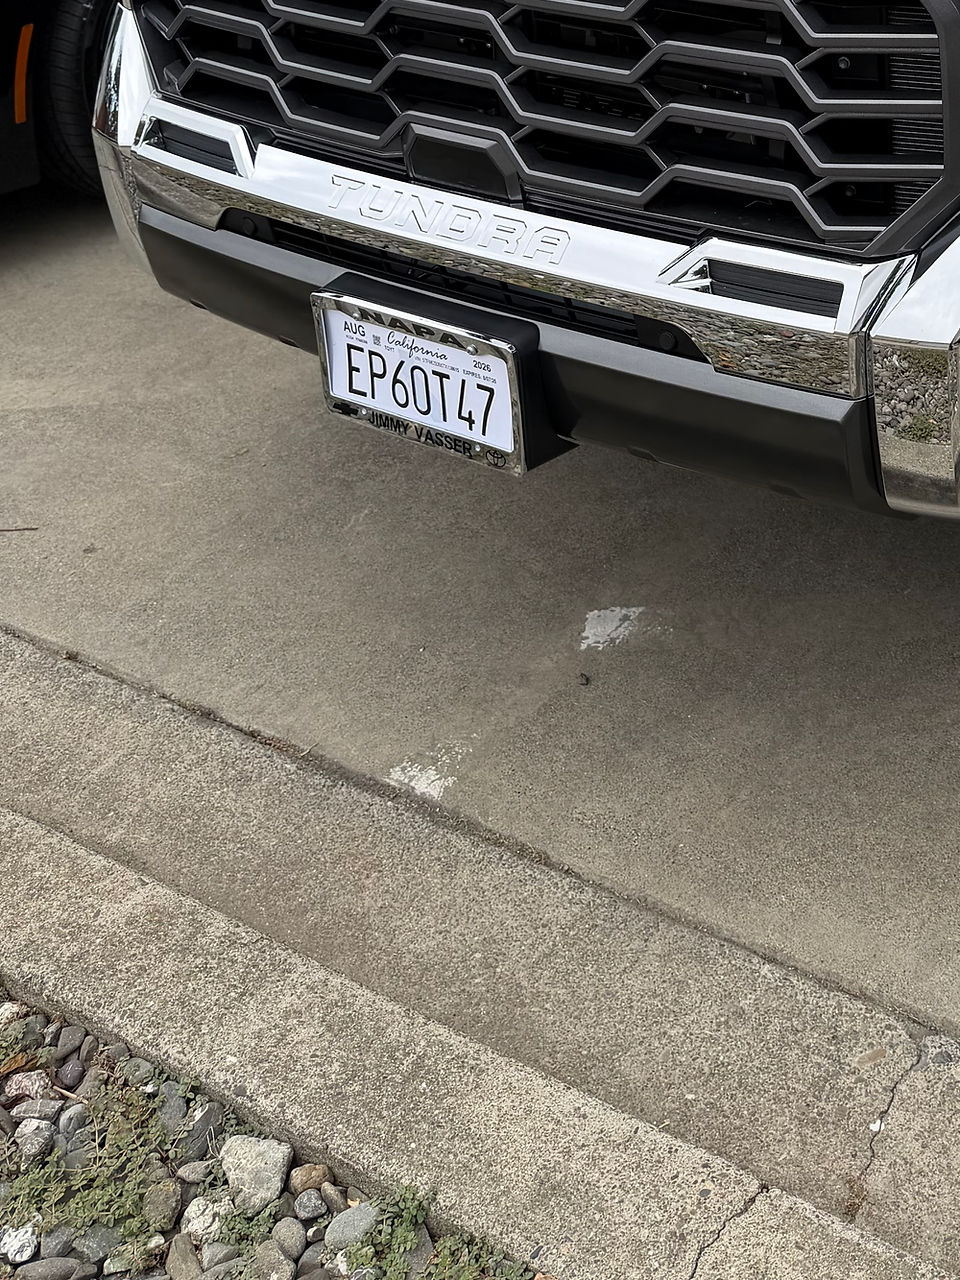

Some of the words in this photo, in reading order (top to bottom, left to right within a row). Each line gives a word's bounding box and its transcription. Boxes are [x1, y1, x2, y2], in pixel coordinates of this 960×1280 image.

[327, 173, 571, 265] TUNDRA
[343, 320, 366, 337] AUG
[359, 308, 467, 350] NAPA
[387, 330, 449, 358] California
[472, 359, 492, 373] 2026
[345, 342, 496, 437] EP60T47
[367, 410, 411, 436] JIMMY
[413, 426, 473, 459] VASSER
